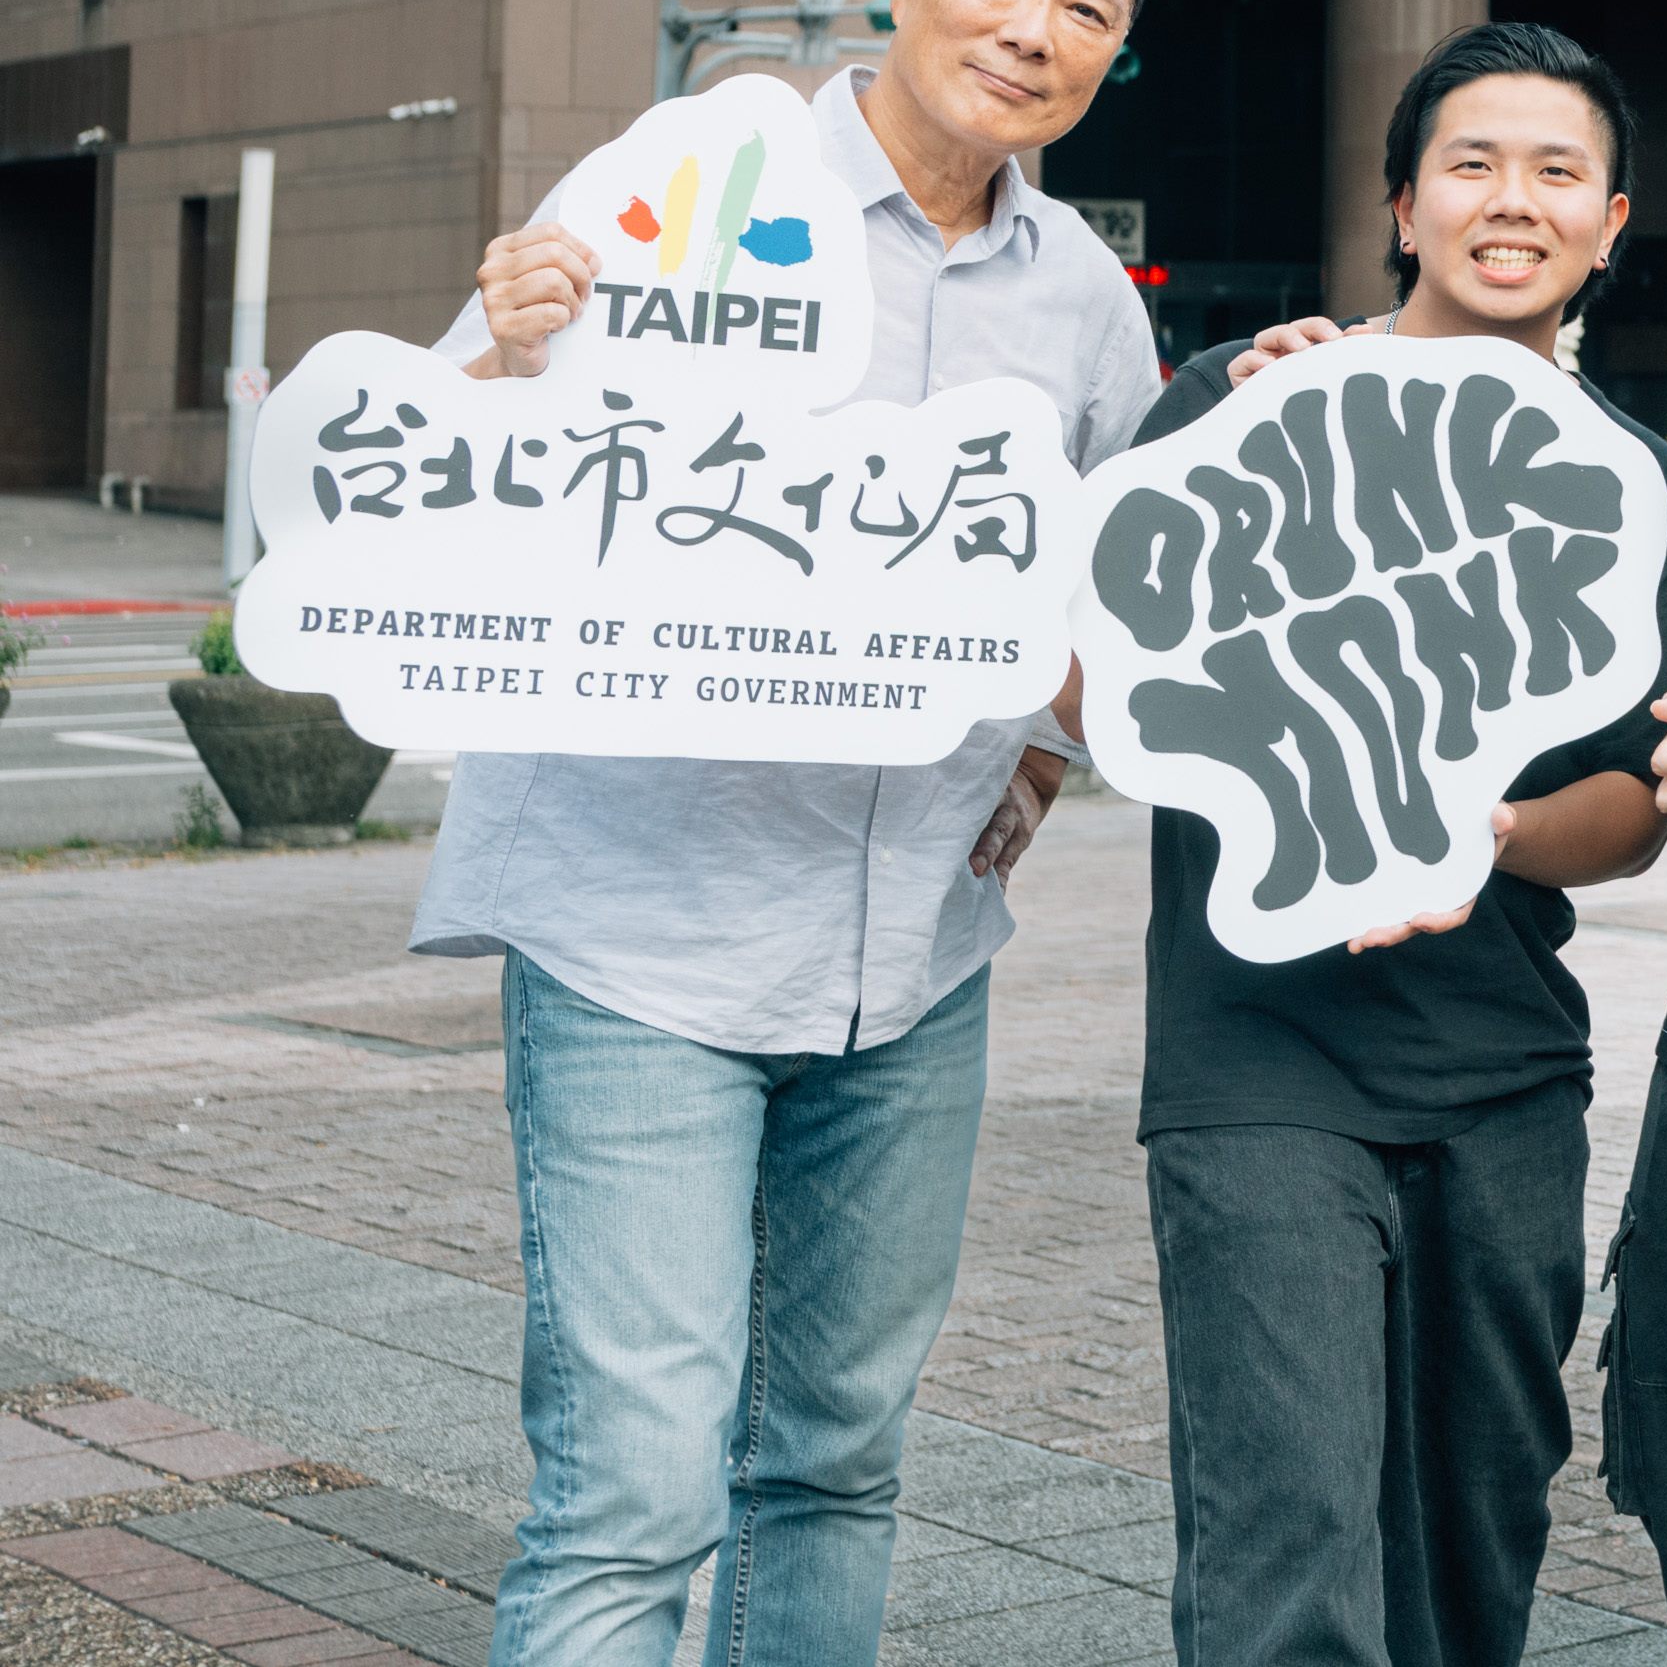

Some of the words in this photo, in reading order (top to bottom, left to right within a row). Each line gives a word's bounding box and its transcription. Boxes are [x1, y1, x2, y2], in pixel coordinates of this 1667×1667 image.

[595, 282, 821, 353] TAIPEI
[313, 388, 1038, 578] 台北市文化局
[1092, 372, 1624, 653] DRUNK
[300, 606, 552, 644] DEPARTMENT
[579, 620, 626, 647] OF
[653, 622, 838, 657] CULTURAL
[864, 633, 1020, 665] AFFAIRS
[400, 664, 545, 696] TAIPEI
[576, 671, 670, 701] CITY
[696, 677, 928, 711] GOVERNMENT
[1128, 526, 1620, 912] MONK
